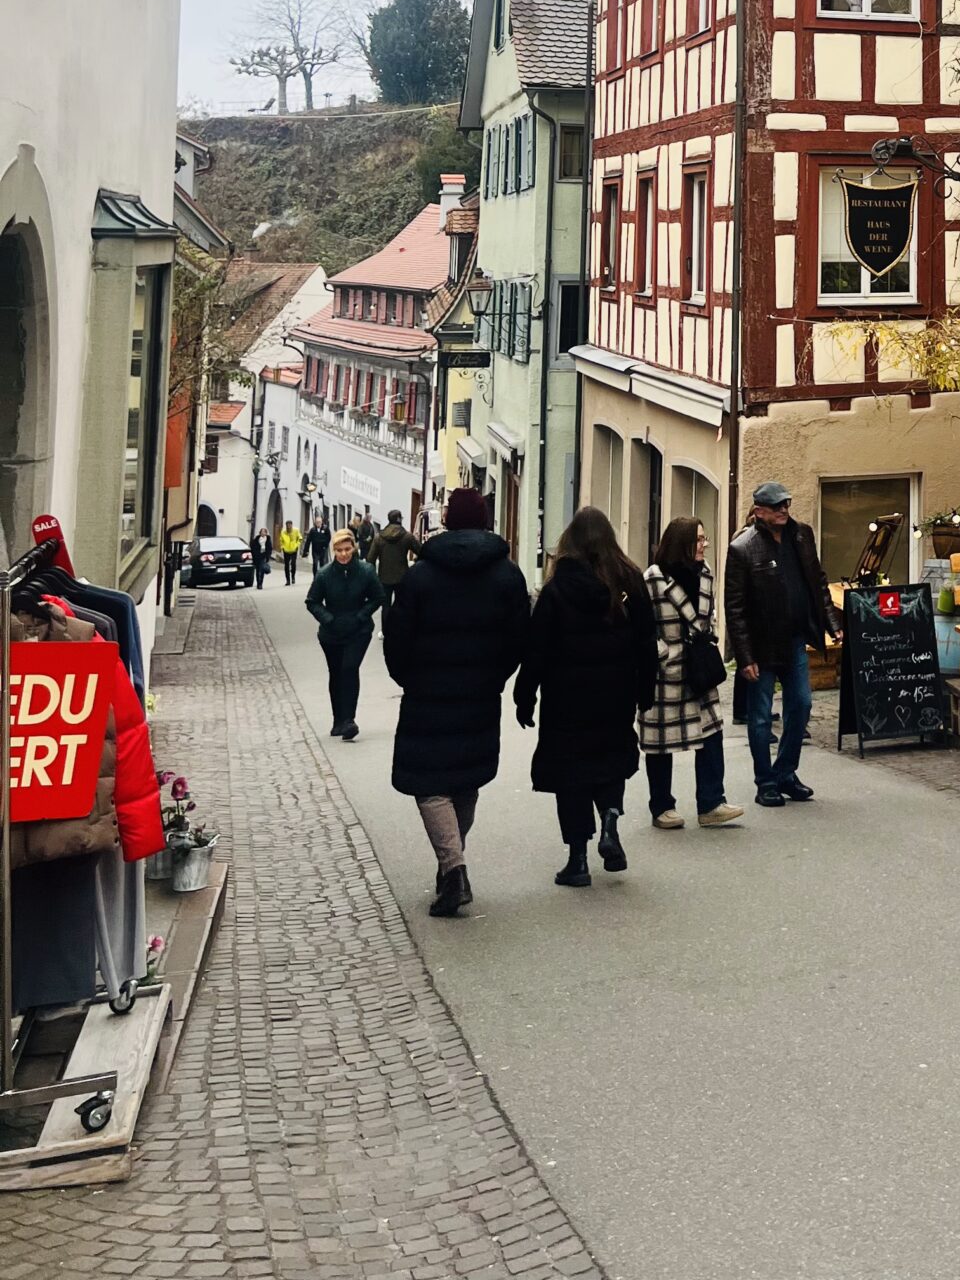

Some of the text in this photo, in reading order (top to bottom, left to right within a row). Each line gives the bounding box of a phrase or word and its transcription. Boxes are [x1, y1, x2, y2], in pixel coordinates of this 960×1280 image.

[851, 199, 907, 208] RESTAURANT
[867, 221, 891, 229] HAUS
[869, 233, 888, 241] DER
[864, 245, 893, 253] WEINE
[34, 519, 58, 533] SALE
